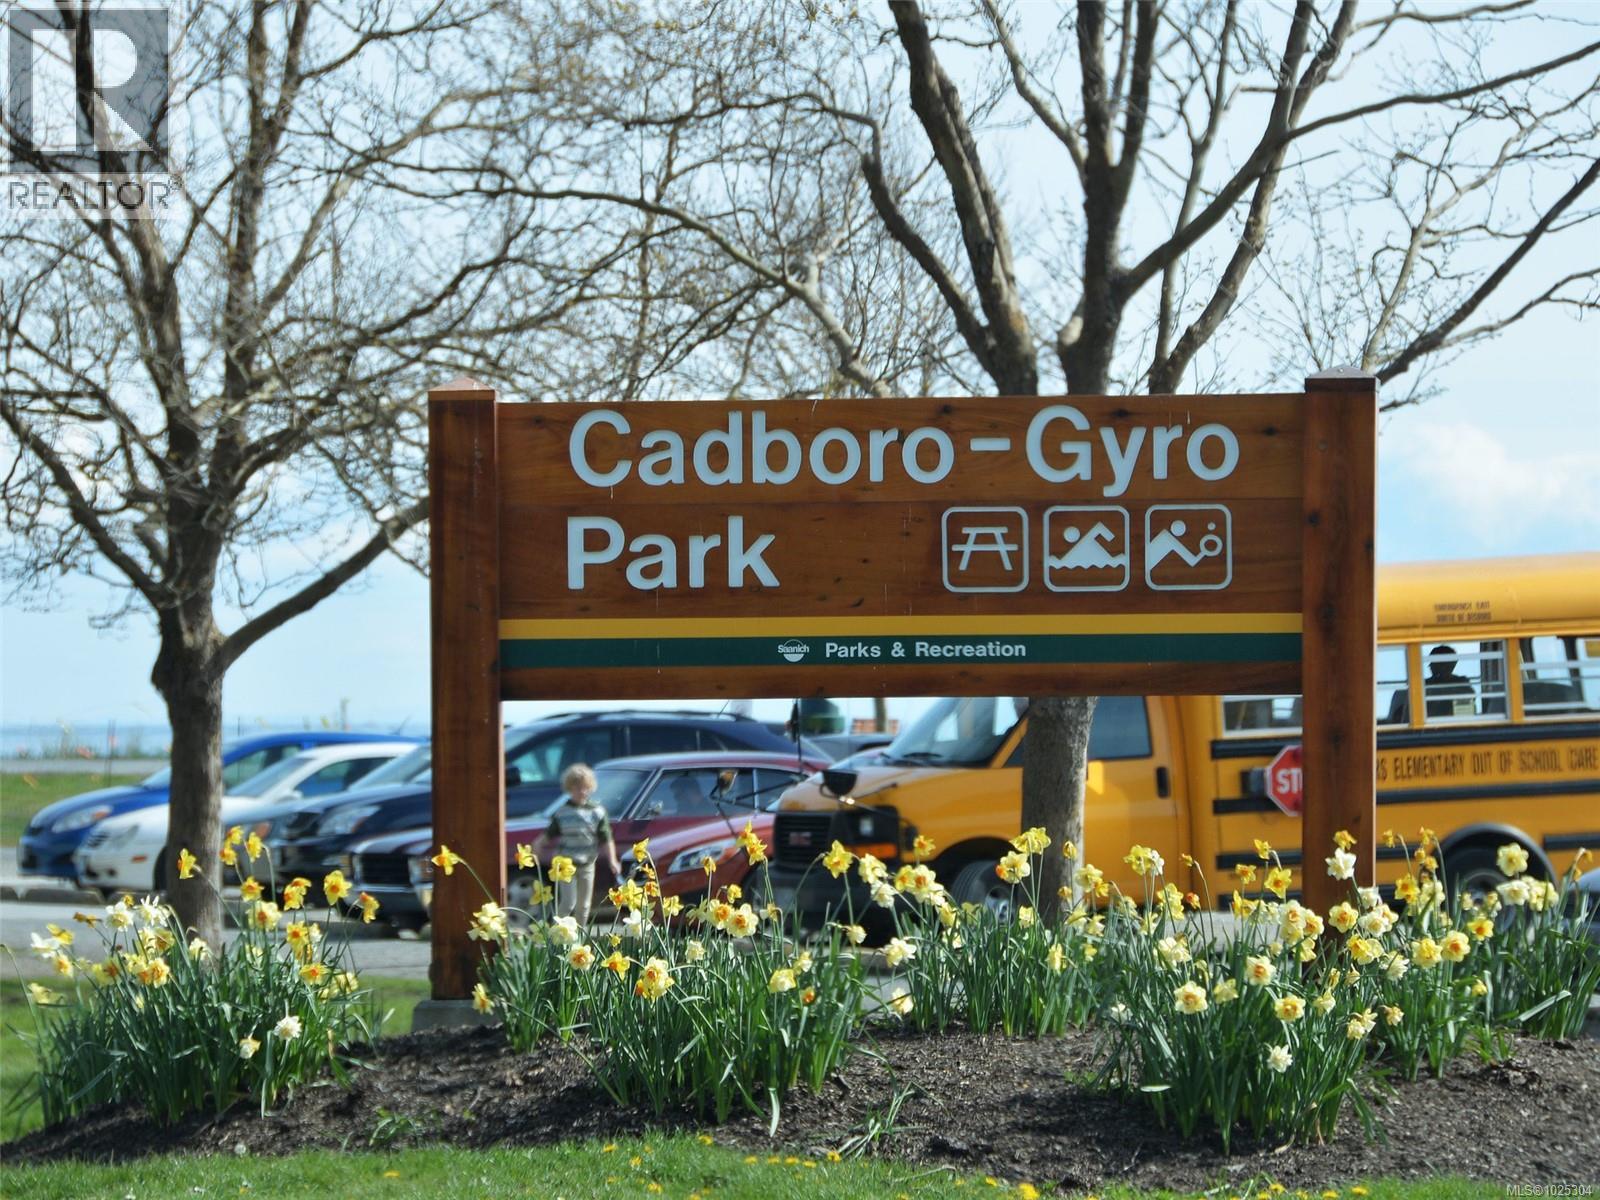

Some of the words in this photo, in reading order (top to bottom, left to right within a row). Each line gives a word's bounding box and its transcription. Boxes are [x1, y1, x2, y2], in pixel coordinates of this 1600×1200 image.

[566, 515, 780, 591] Park
[777, 643, 810, 654] Saanich
[825, 642, 881, 658] Parks
[891, 642, 906, 658] &
[915, 641, 1027, 657] Recreation
[1393, 752, 1465, 781] ELEMENTARY
[1472, 751, 1493, 776] OUT
[1499, 750, 1513, 775] OF
[1519, 748, 1561, 773] SCHOOL
